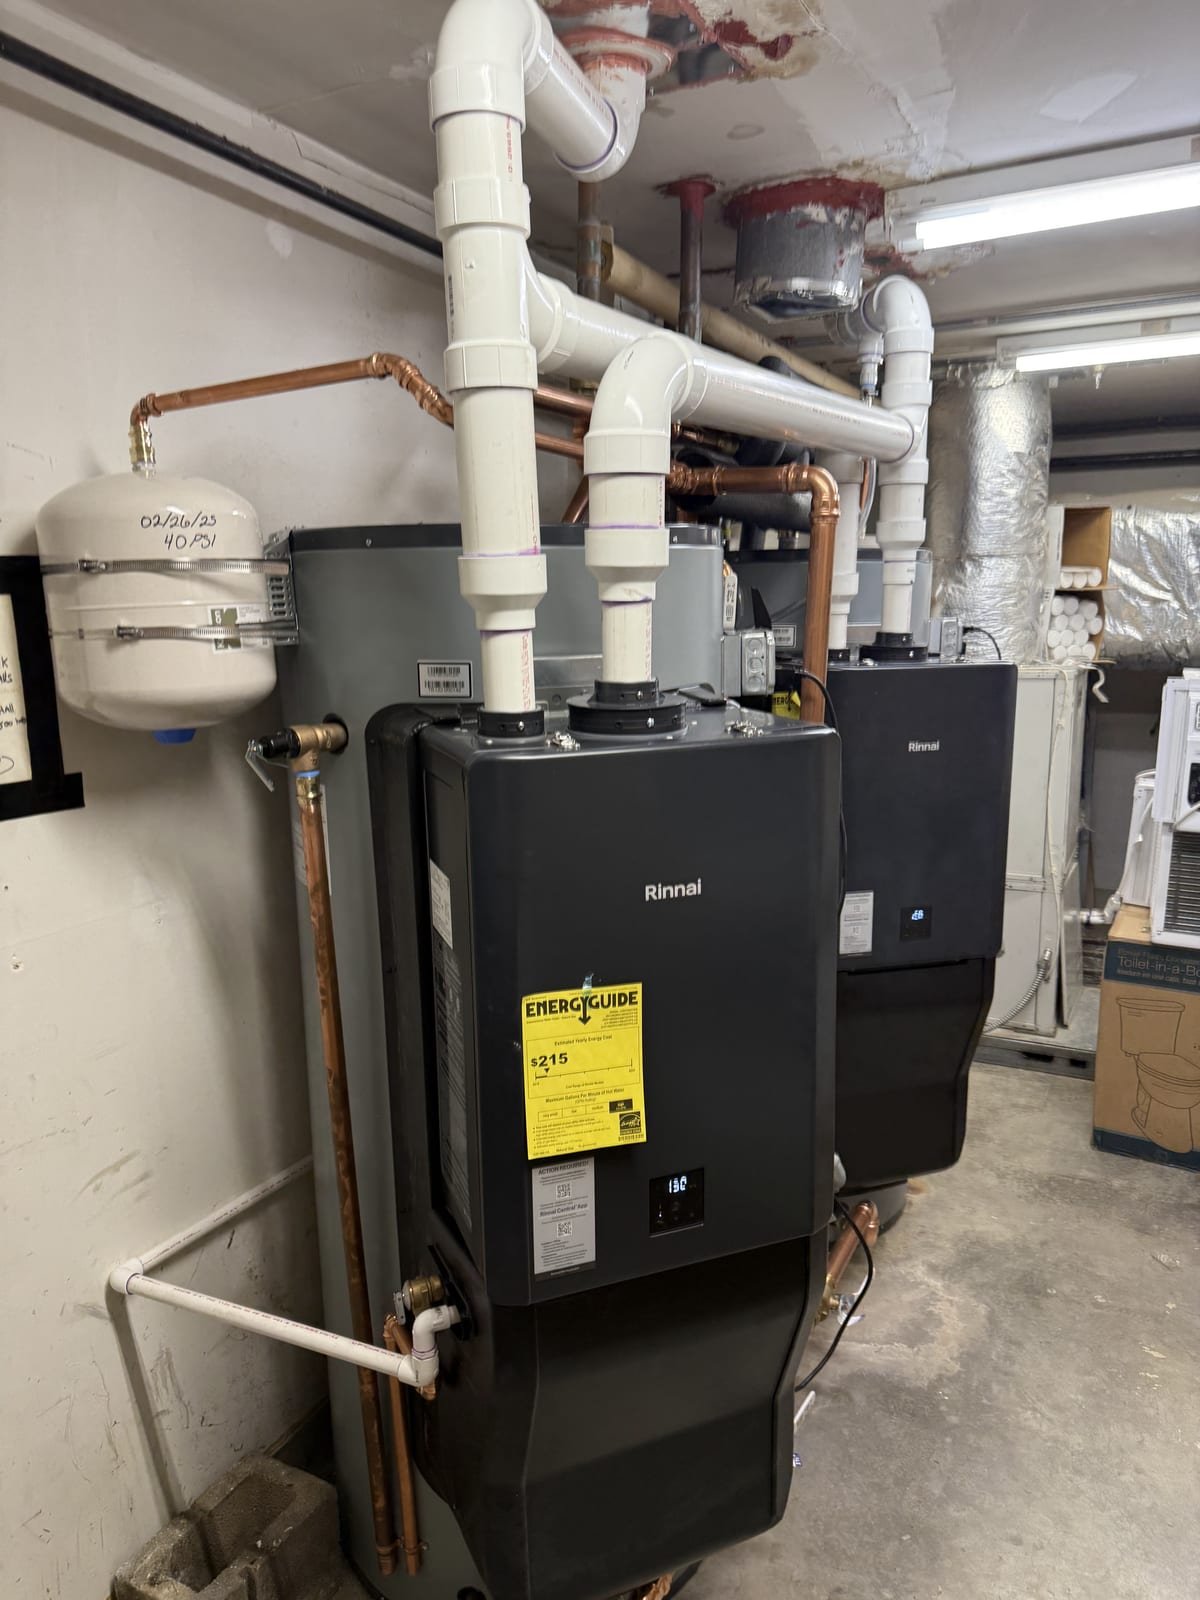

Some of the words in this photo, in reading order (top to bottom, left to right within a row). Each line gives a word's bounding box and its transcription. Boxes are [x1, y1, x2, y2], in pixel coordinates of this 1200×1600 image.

[164, 533, 187, 550] 40
[189, 533, 216, 549] PSI
[908, 739, 940, 752] Rinnai
[645, 877, 702, 901] Rinnai
[531, 1052, 568, 1067] $215
[538, 1167, 559, 1175] ACTION
